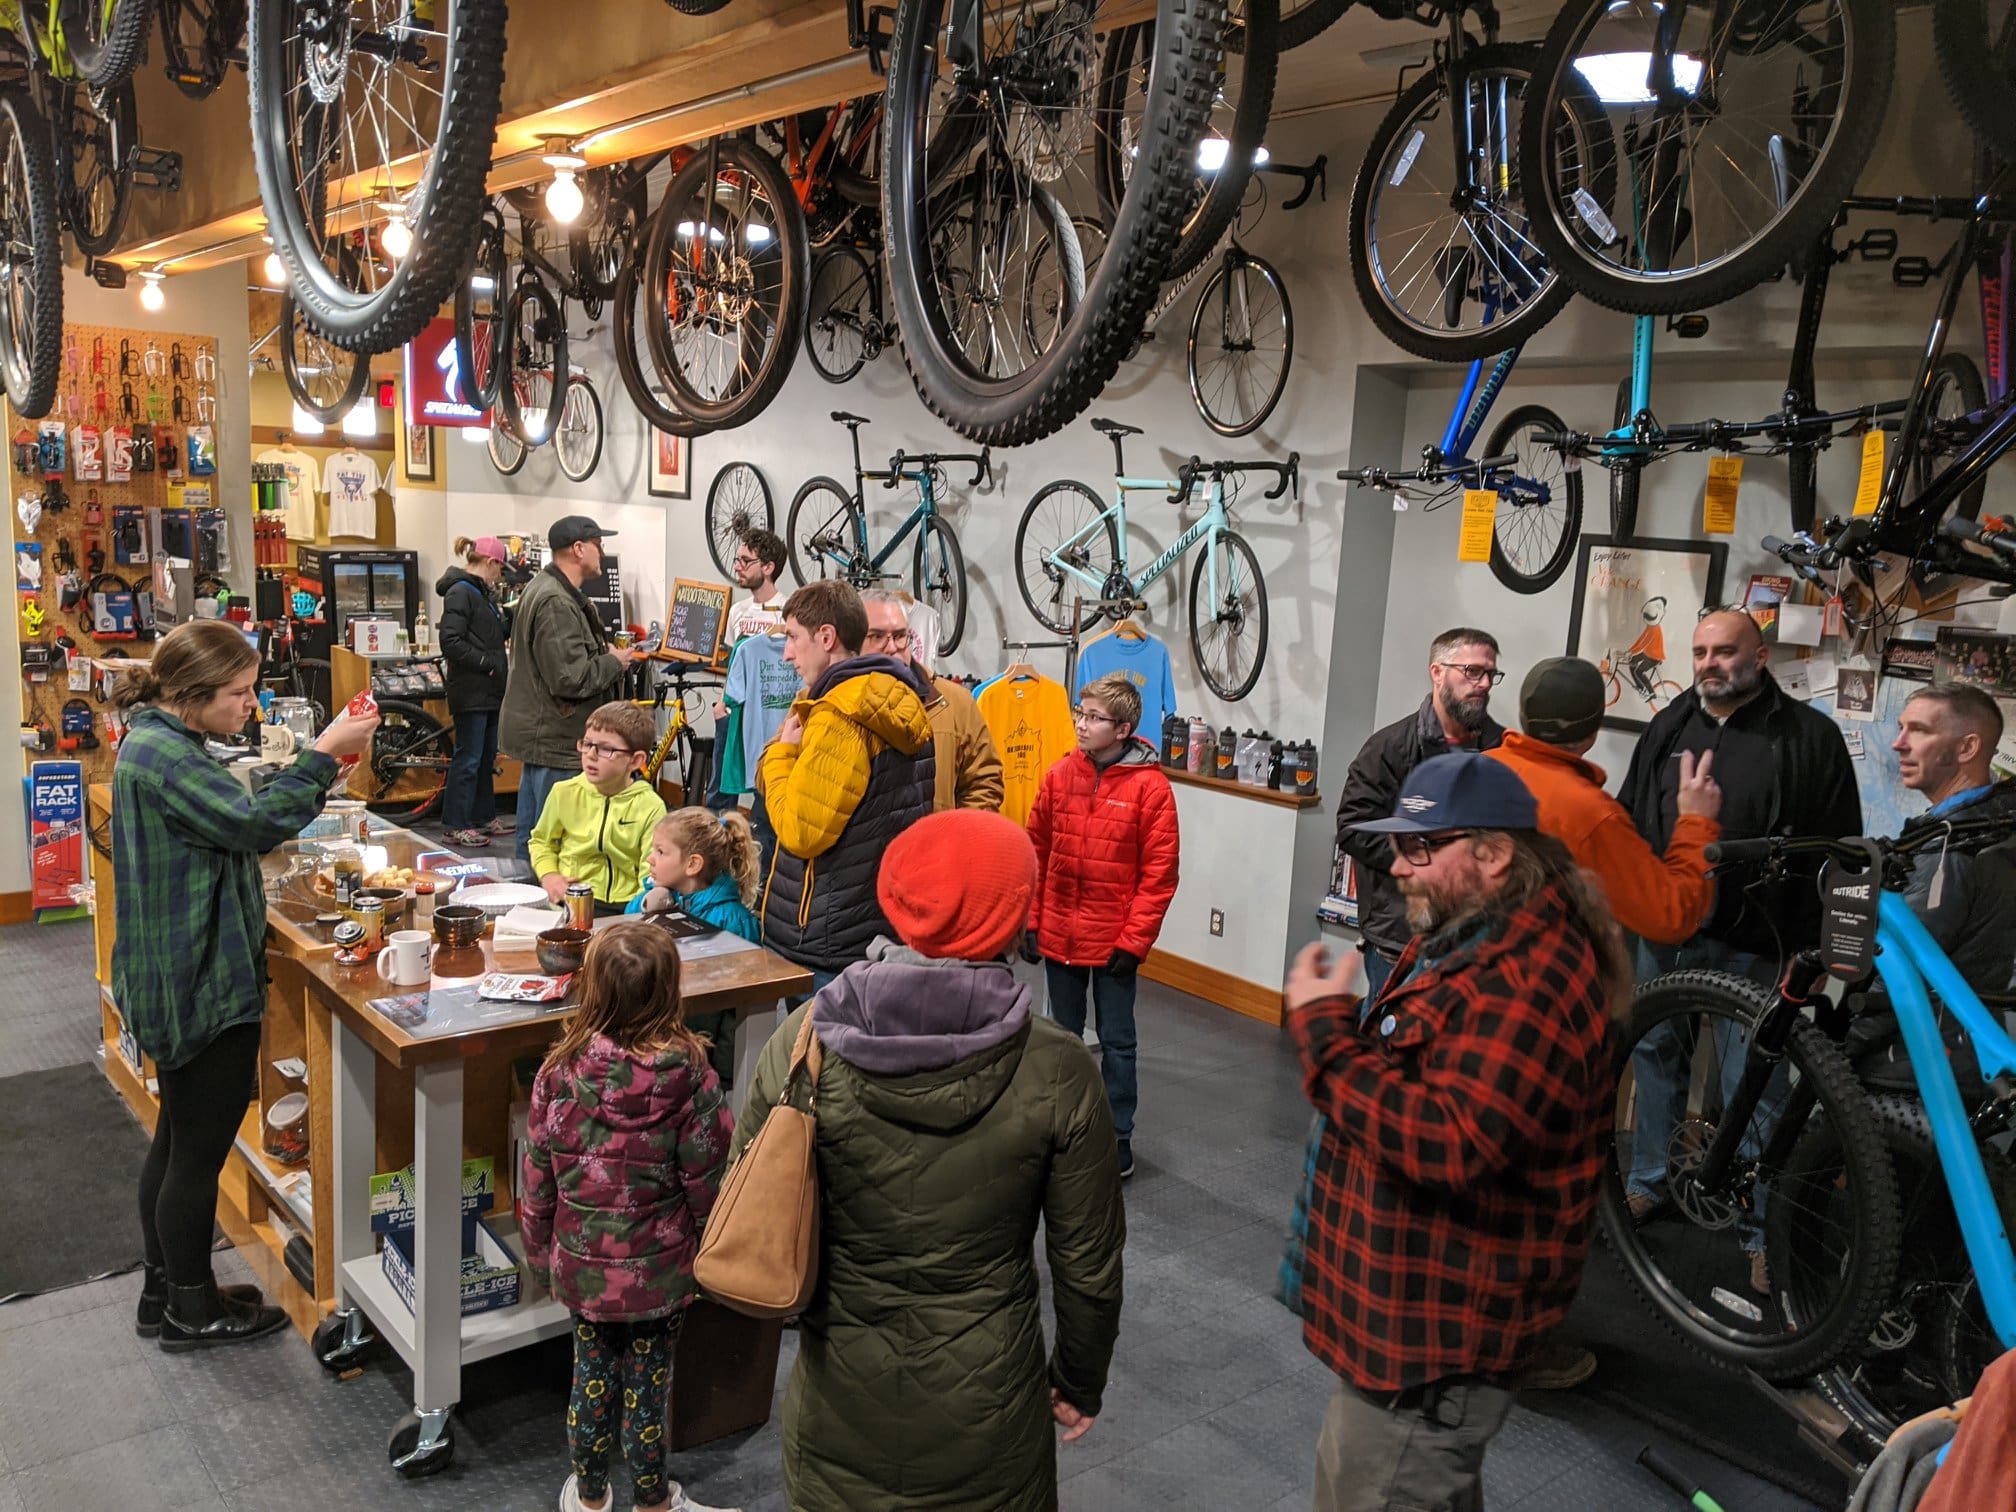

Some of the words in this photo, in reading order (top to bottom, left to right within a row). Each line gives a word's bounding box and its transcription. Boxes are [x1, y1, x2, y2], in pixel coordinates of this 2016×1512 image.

[1140, 524, 1199, 588] SPECIALIZED
[759, 660, 775, 673] Dirt
[36, 784, 79, 799] FAT
[36, 796, 78, 807] RACK
[1832, 884, 1871, 900] OUTRIDE
